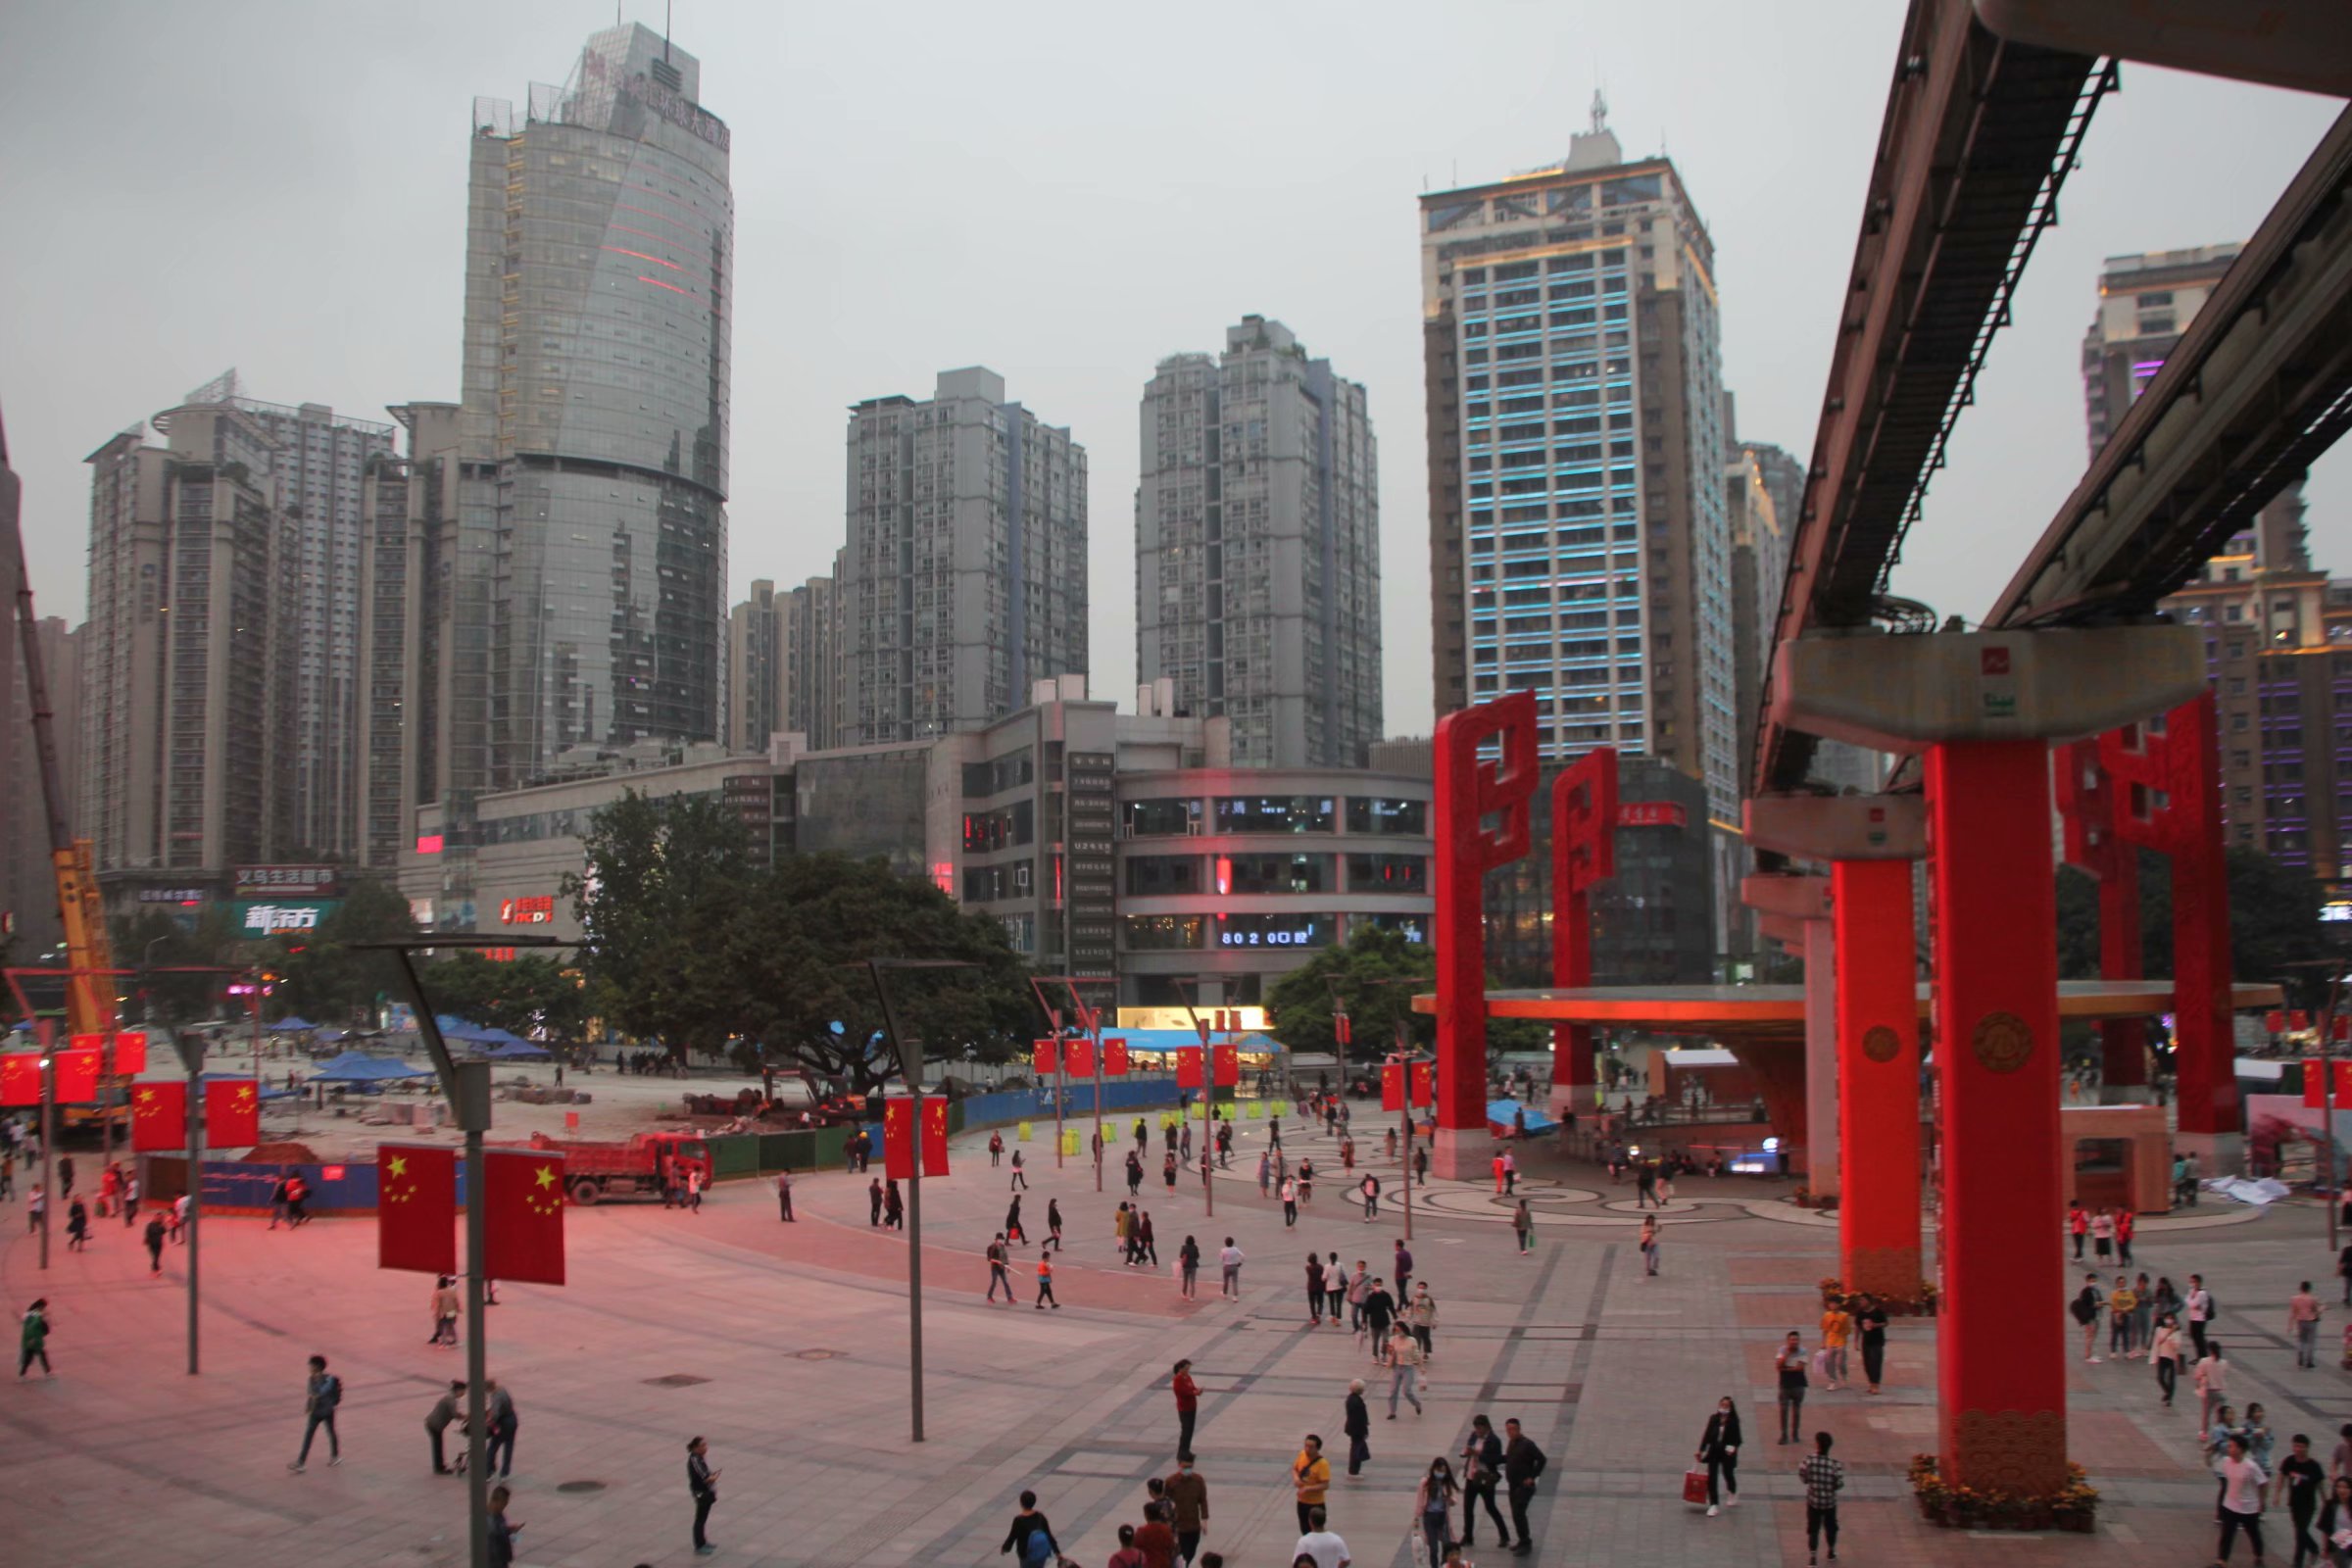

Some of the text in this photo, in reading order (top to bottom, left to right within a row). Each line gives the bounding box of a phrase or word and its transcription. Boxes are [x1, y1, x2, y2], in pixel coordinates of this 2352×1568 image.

[236, 869, 333, 884] 义乌生活超市
[244, 905, 319, 935] 新东方
